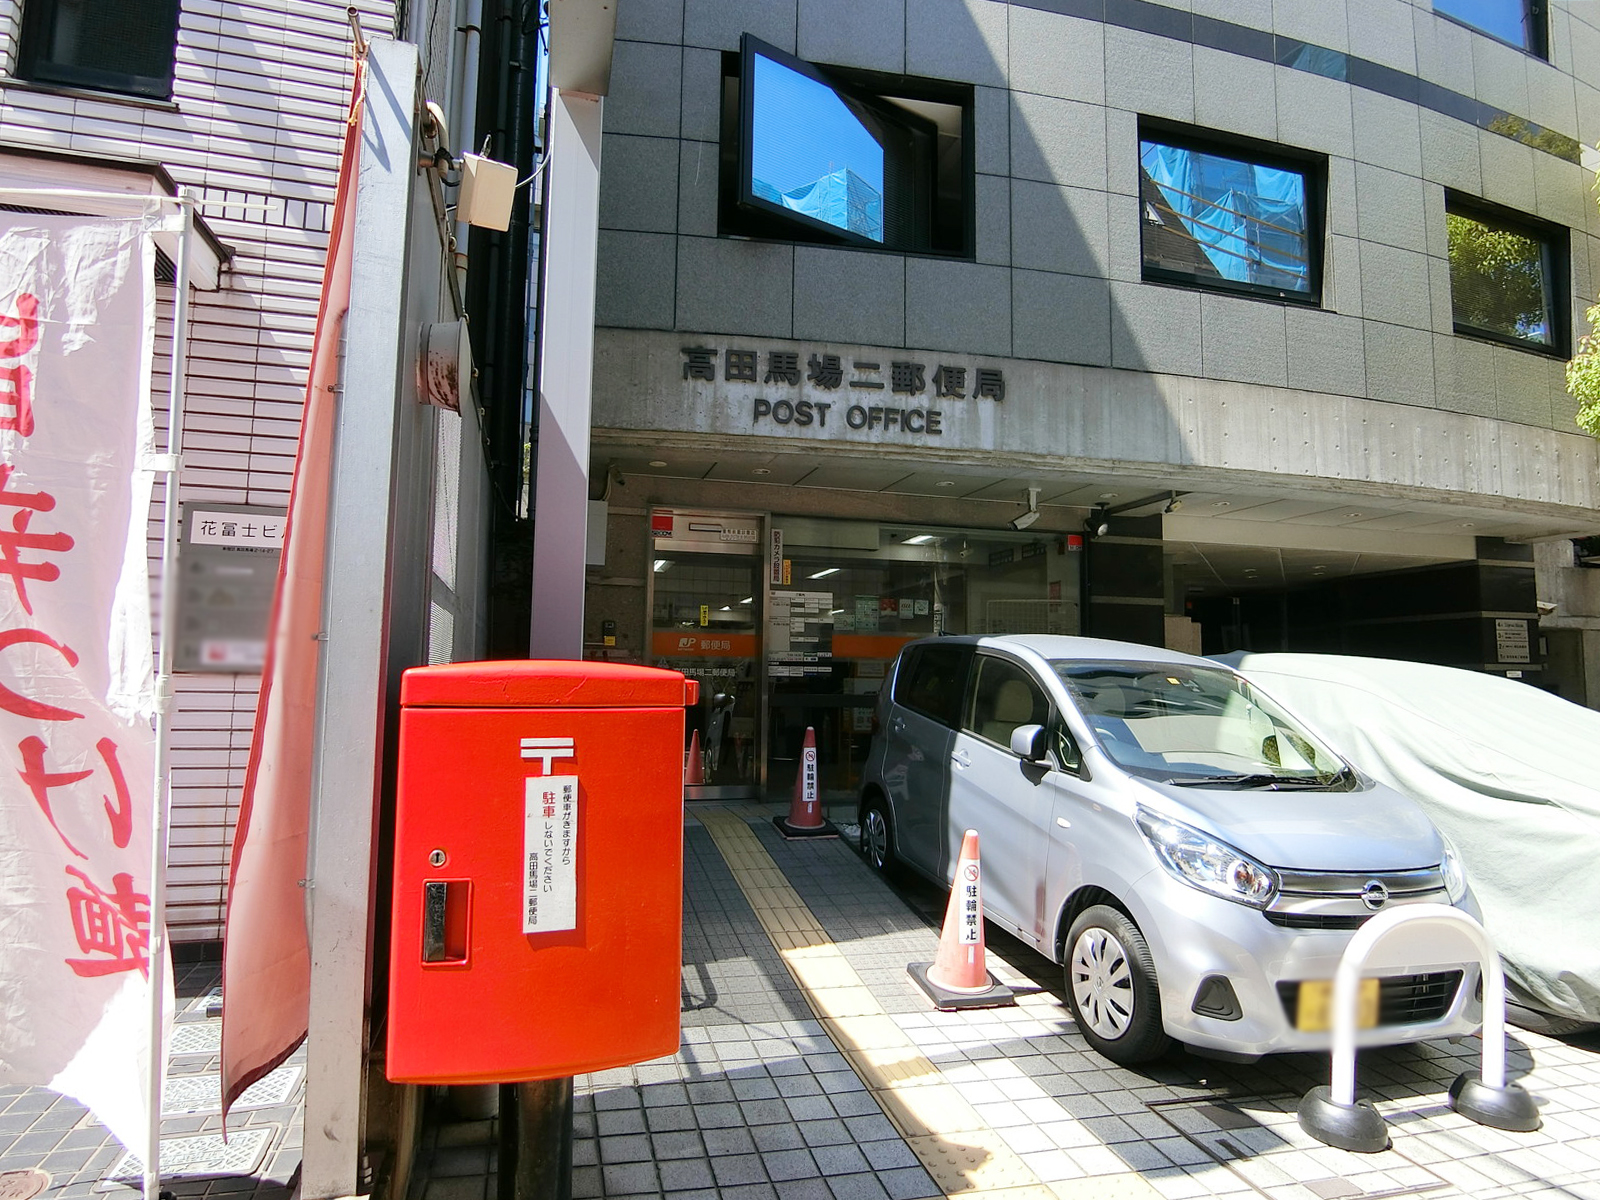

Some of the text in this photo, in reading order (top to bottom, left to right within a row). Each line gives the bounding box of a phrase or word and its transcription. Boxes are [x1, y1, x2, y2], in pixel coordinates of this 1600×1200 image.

[681, 346, 1006, 402] 高田馬場二郵便局
[753, 398, 943, 435] POST OFFICE
[201, 519, 285, 539] 花冨士ビ
[701, 640, 731, 651] 郵便局
[806, 763, 816, 800] 駐輪禁止
[562, 785, 573, 866] 郵便車がきますから
[527, 852, 539, 926] 高田馬場二郵便局
[966, 884, 979, 941] 駐輪禁止
